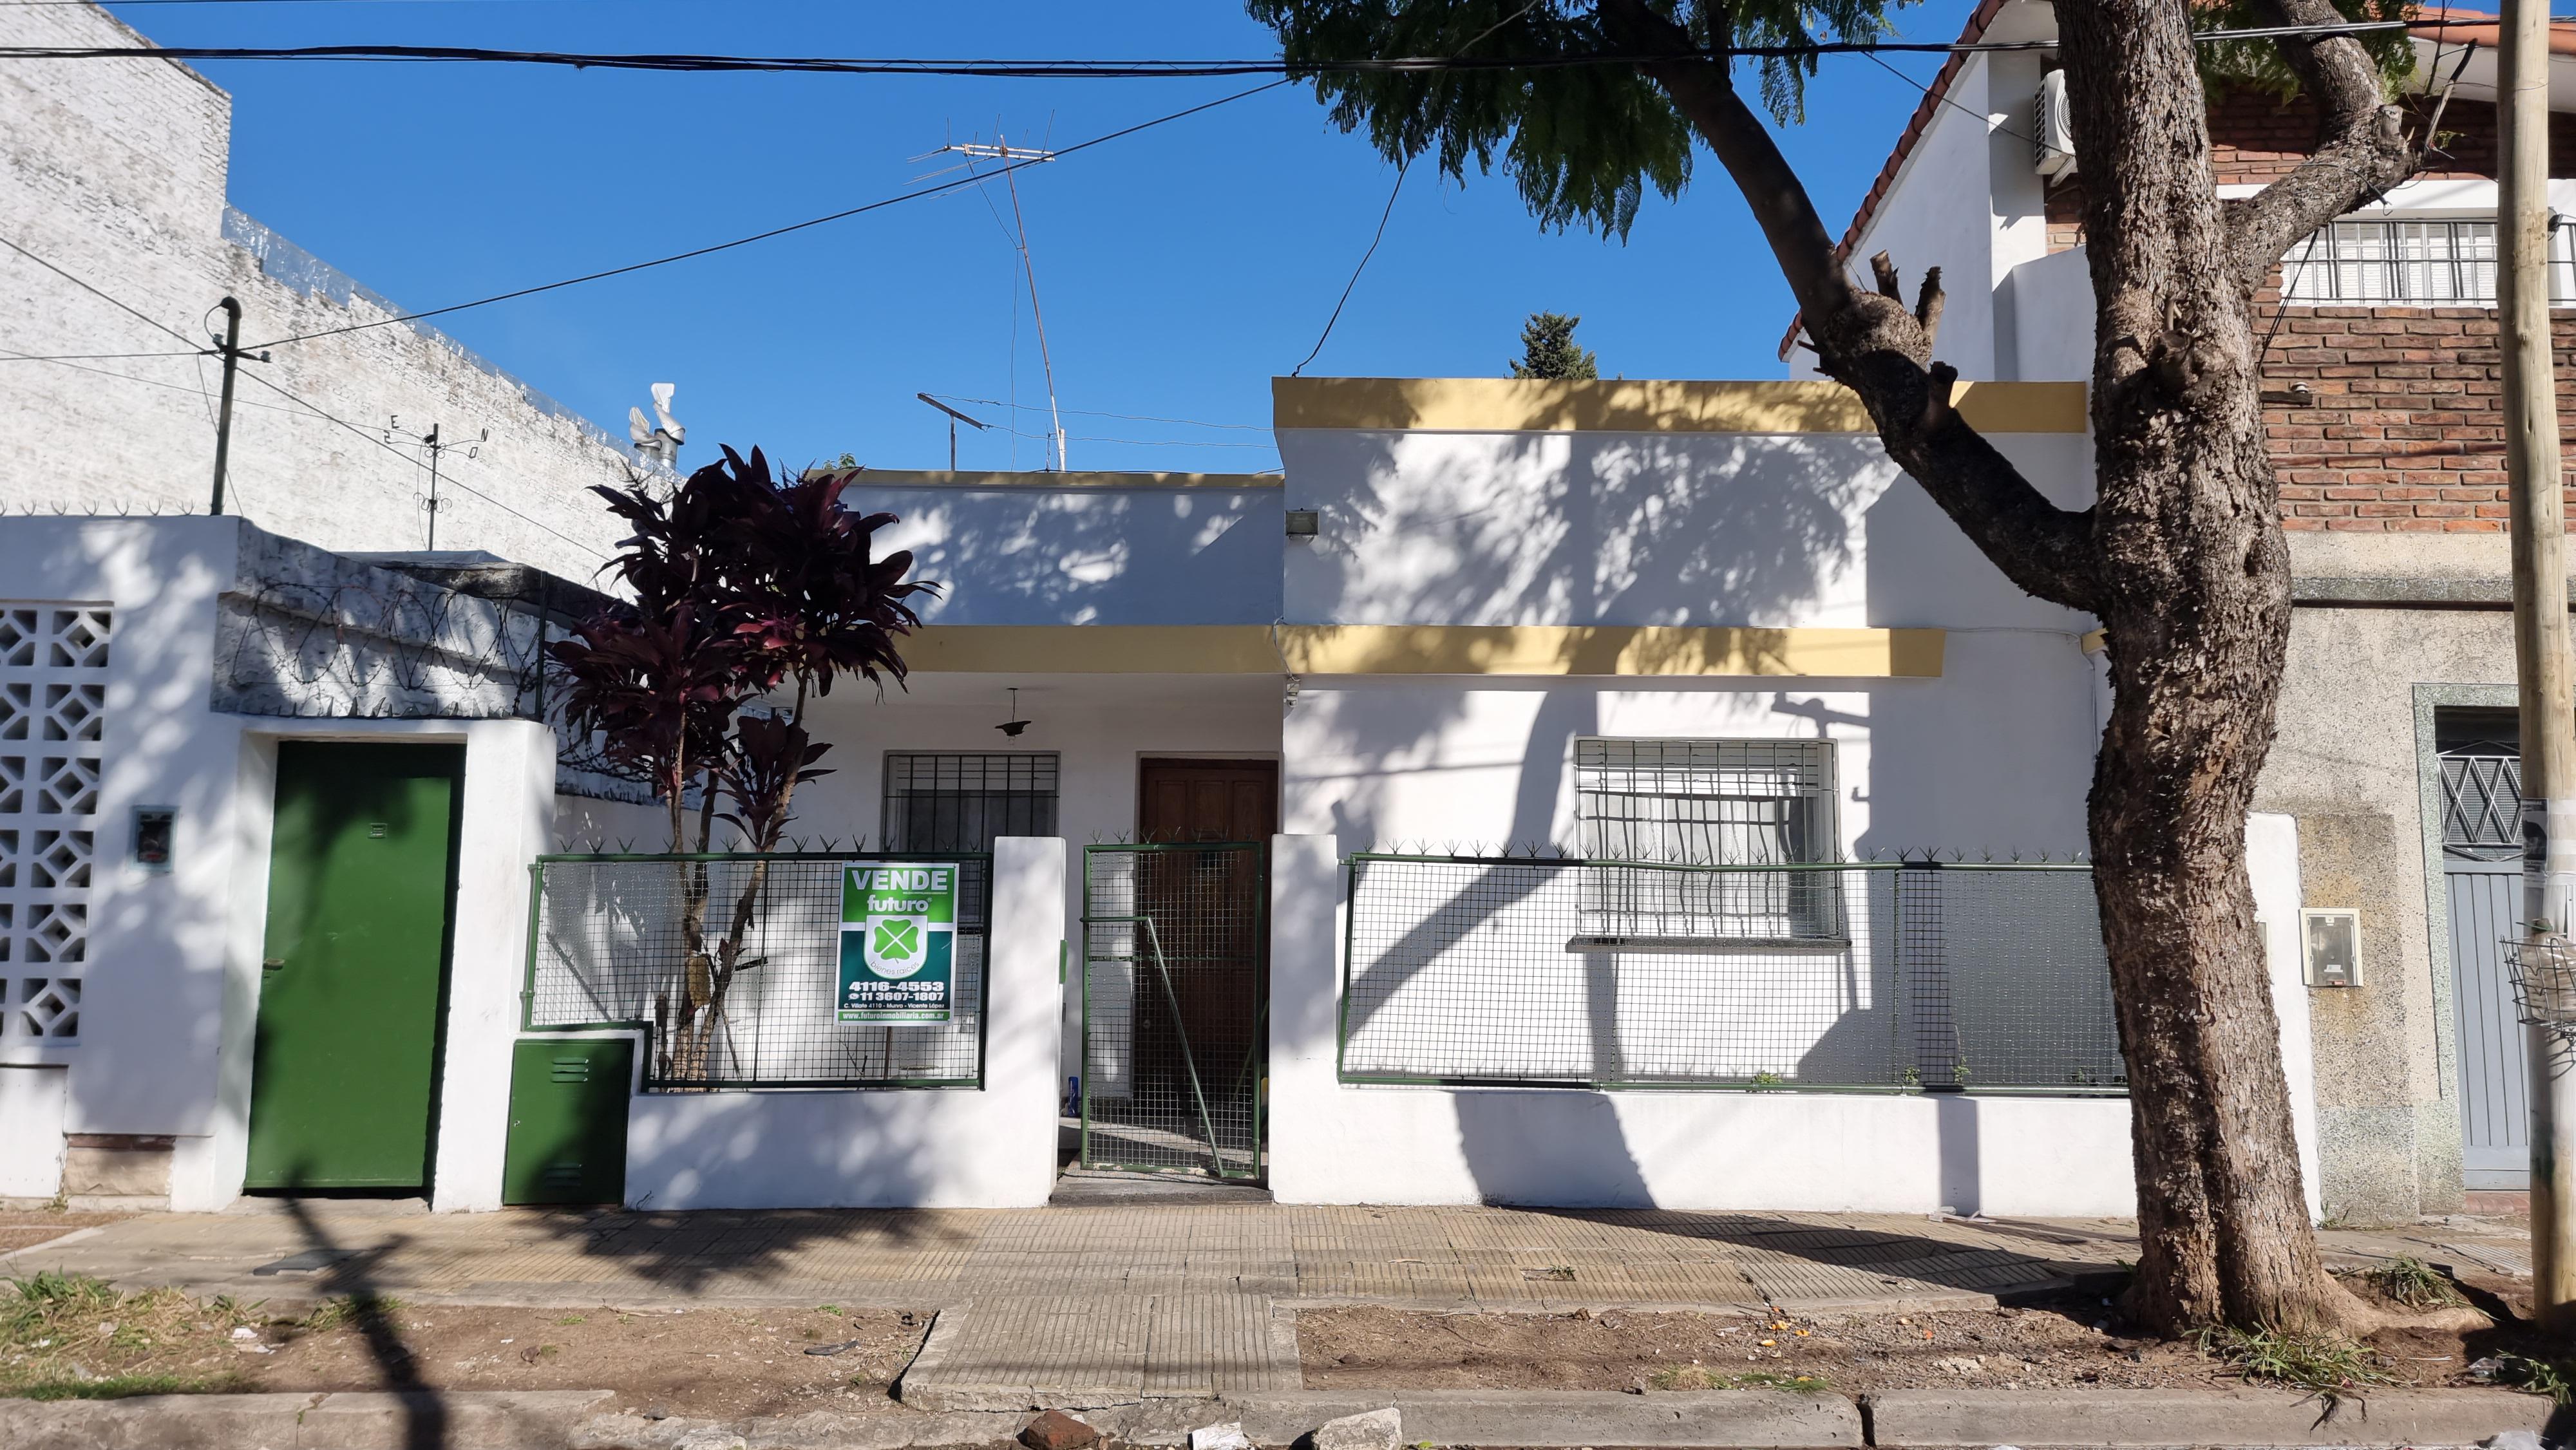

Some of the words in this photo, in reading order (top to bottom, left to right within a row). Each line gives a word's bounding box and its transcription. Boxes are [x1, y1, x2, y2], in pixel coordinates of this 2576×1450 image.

[851, 870, 948, 890] VENDE
[867, 894, 929, 912] futuro
[871, 961, 895, 975] bienes
[849, 981, 944, 992] 4116-4553
[860, 992, 873, 1001] 11
[875, 992, 944, 1001] 3607-1807
